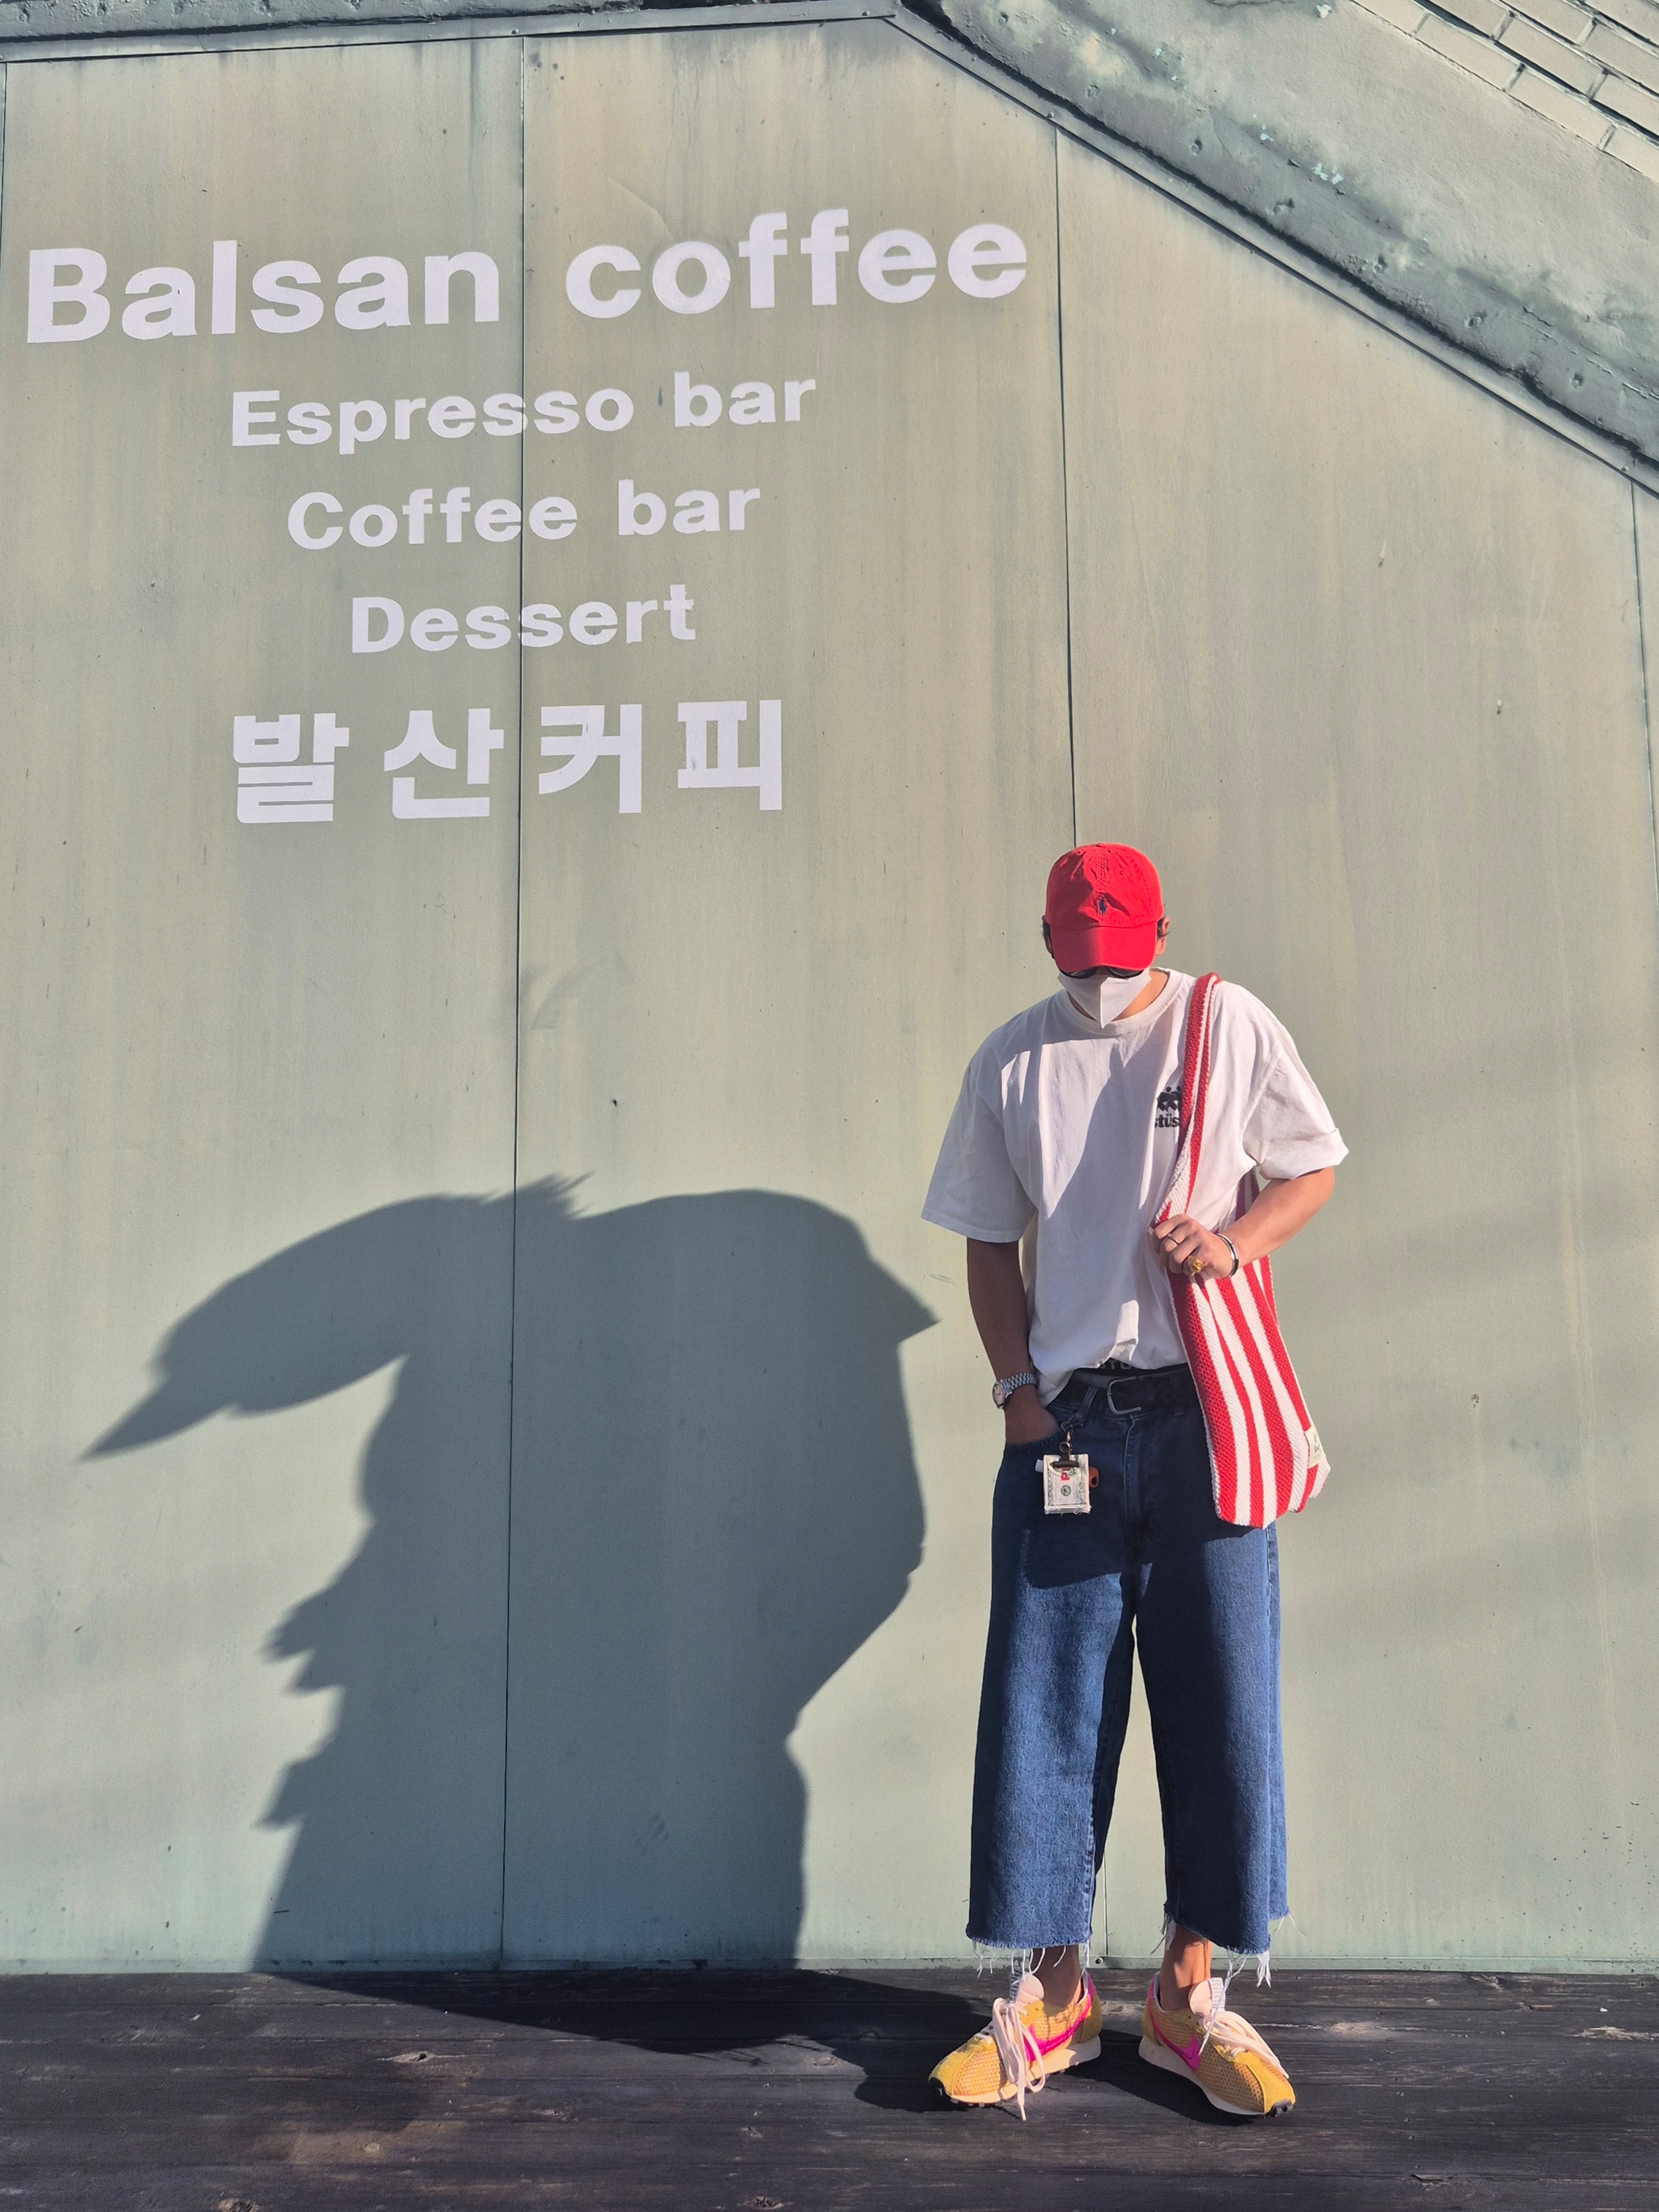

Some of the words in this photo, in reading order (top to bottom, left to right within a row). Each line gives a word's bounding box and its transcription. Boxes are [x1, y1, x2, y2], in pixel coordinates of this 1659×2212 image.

[27, 239, 500, 344] Balsan
[565, 208, 1027, 319] coffee
[232, 388, 635, 455] Espresso
[673, 371, 816, 427] bar
[287, 486, 578, 550] Coffee
[618, 478, 761, 536] bar
[351, 584, 696, 653] Dessert
[232, 699, 782, 824] 발산커피
